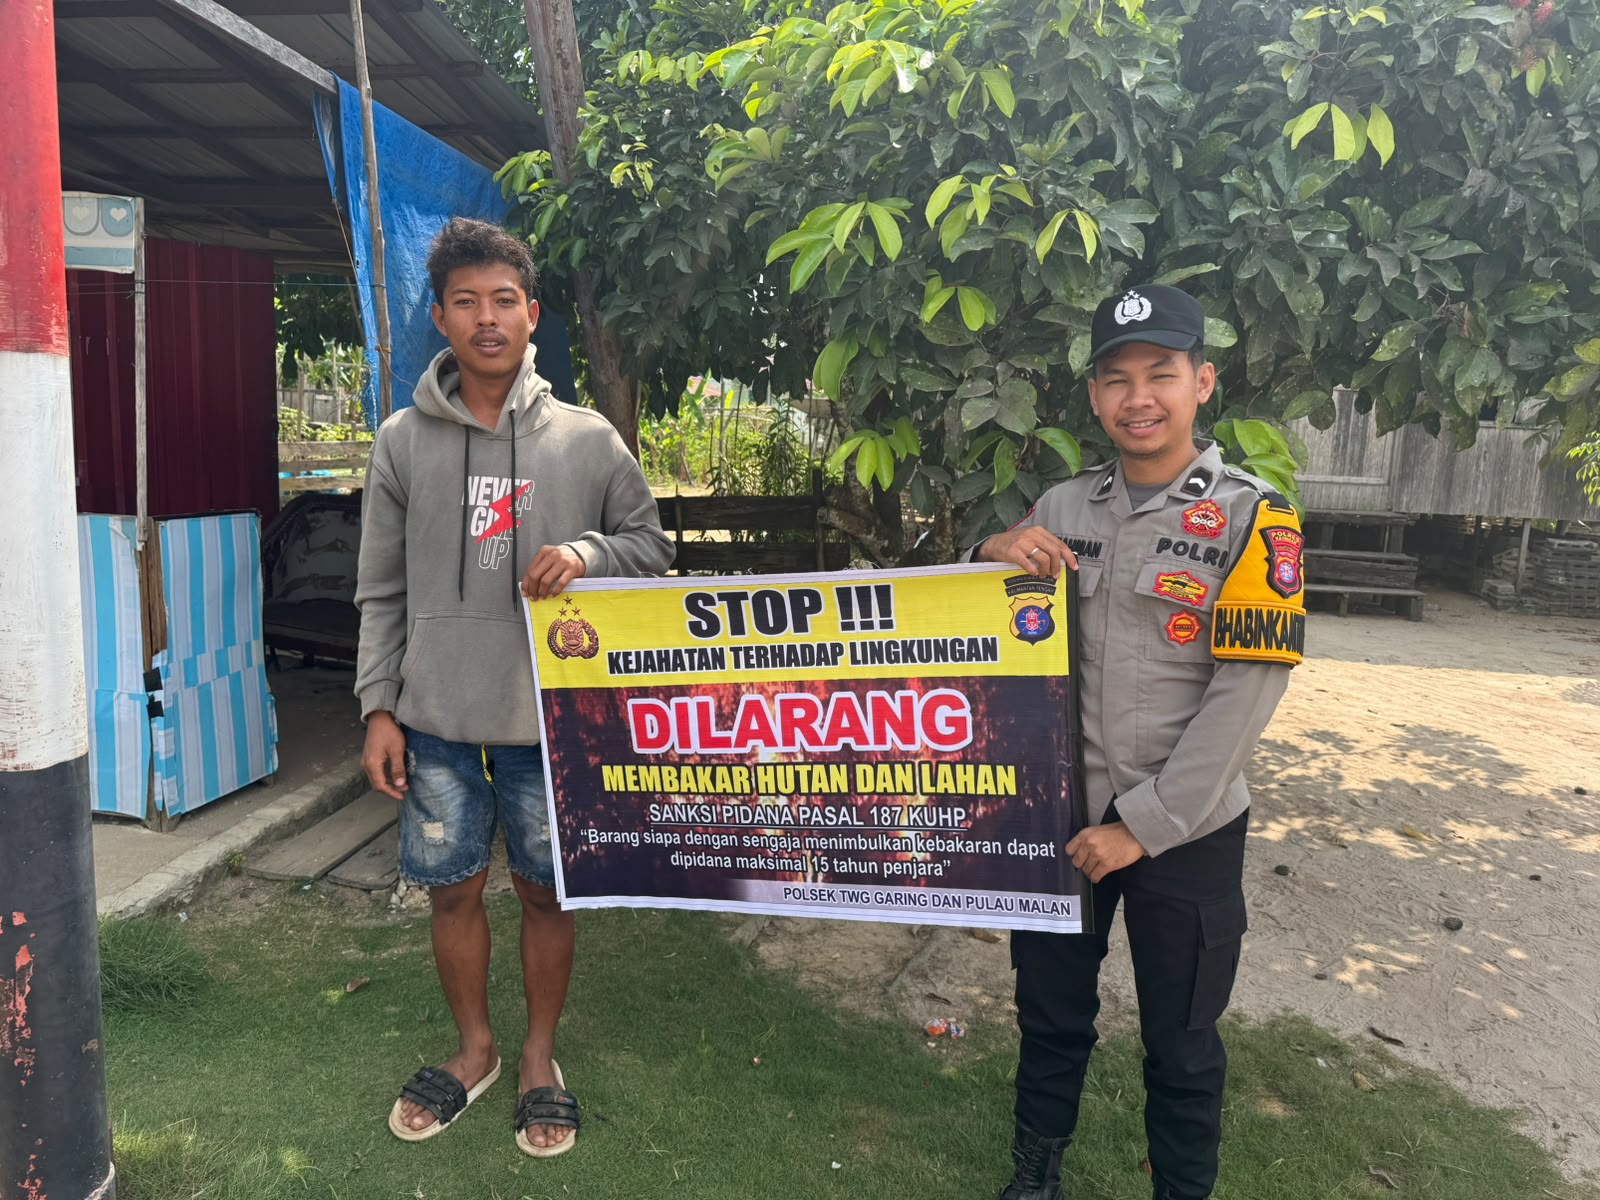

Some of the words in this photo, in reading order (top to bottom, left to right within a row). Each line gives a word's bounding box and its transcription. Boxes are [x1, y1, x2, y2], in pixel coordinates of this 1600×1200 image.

[478, 538, 510, 569] UP
[1156, 537, 1229, 569] POLRI
[685, 588, 822, 638] STOP
[835, 584, 894, 632] !!!
[607, 647, 725, 674] KEJAHATAN
[731, 642, 844, 670] TERHADAP
[850, 637, 998, 665] LINGKUNGAN
[630, 692, 970, 751] DILARANG
[602, 765, 750, 794] MEMBAKAR
[757, 764, 848, 794] HUTAN
[856, 763, 914, 794] DAN
[921, 764, 1017, 796] LAHAN
[650, 804, 717, 823] SANKSI
[722, 805, 795, 825] PIDANA
[800, 806, 864, 826] PASAL
[869, 806, 902, 827] 187
[909, 806, 966, 828] KUHP
[643, 830, 681, 847] siapa
[686, 830, 738, 849] dengan
[743, 832, 800, 851] sengaja
[805, 834, 914, 852] menimbulkan
[916, 836, 1001, 855] kebakaran
[1008, 838, 1056, 860] dapat
[670, 851, 732, 869] dipidana
[736, 854, 807, 872] maksimal
[811, 856, 829, 872] 15
[833, 857, 878, 874] tahun
[783, 887, 836, 902] POLSEK
[839, 890, 870, 904] TWG
[874, 891, 928, 907] GARING
[932, 893, 962, 909] DAN
[966, 895, 1015, 912] PULAU
[1019, 899, 1071, 916] MALAN
